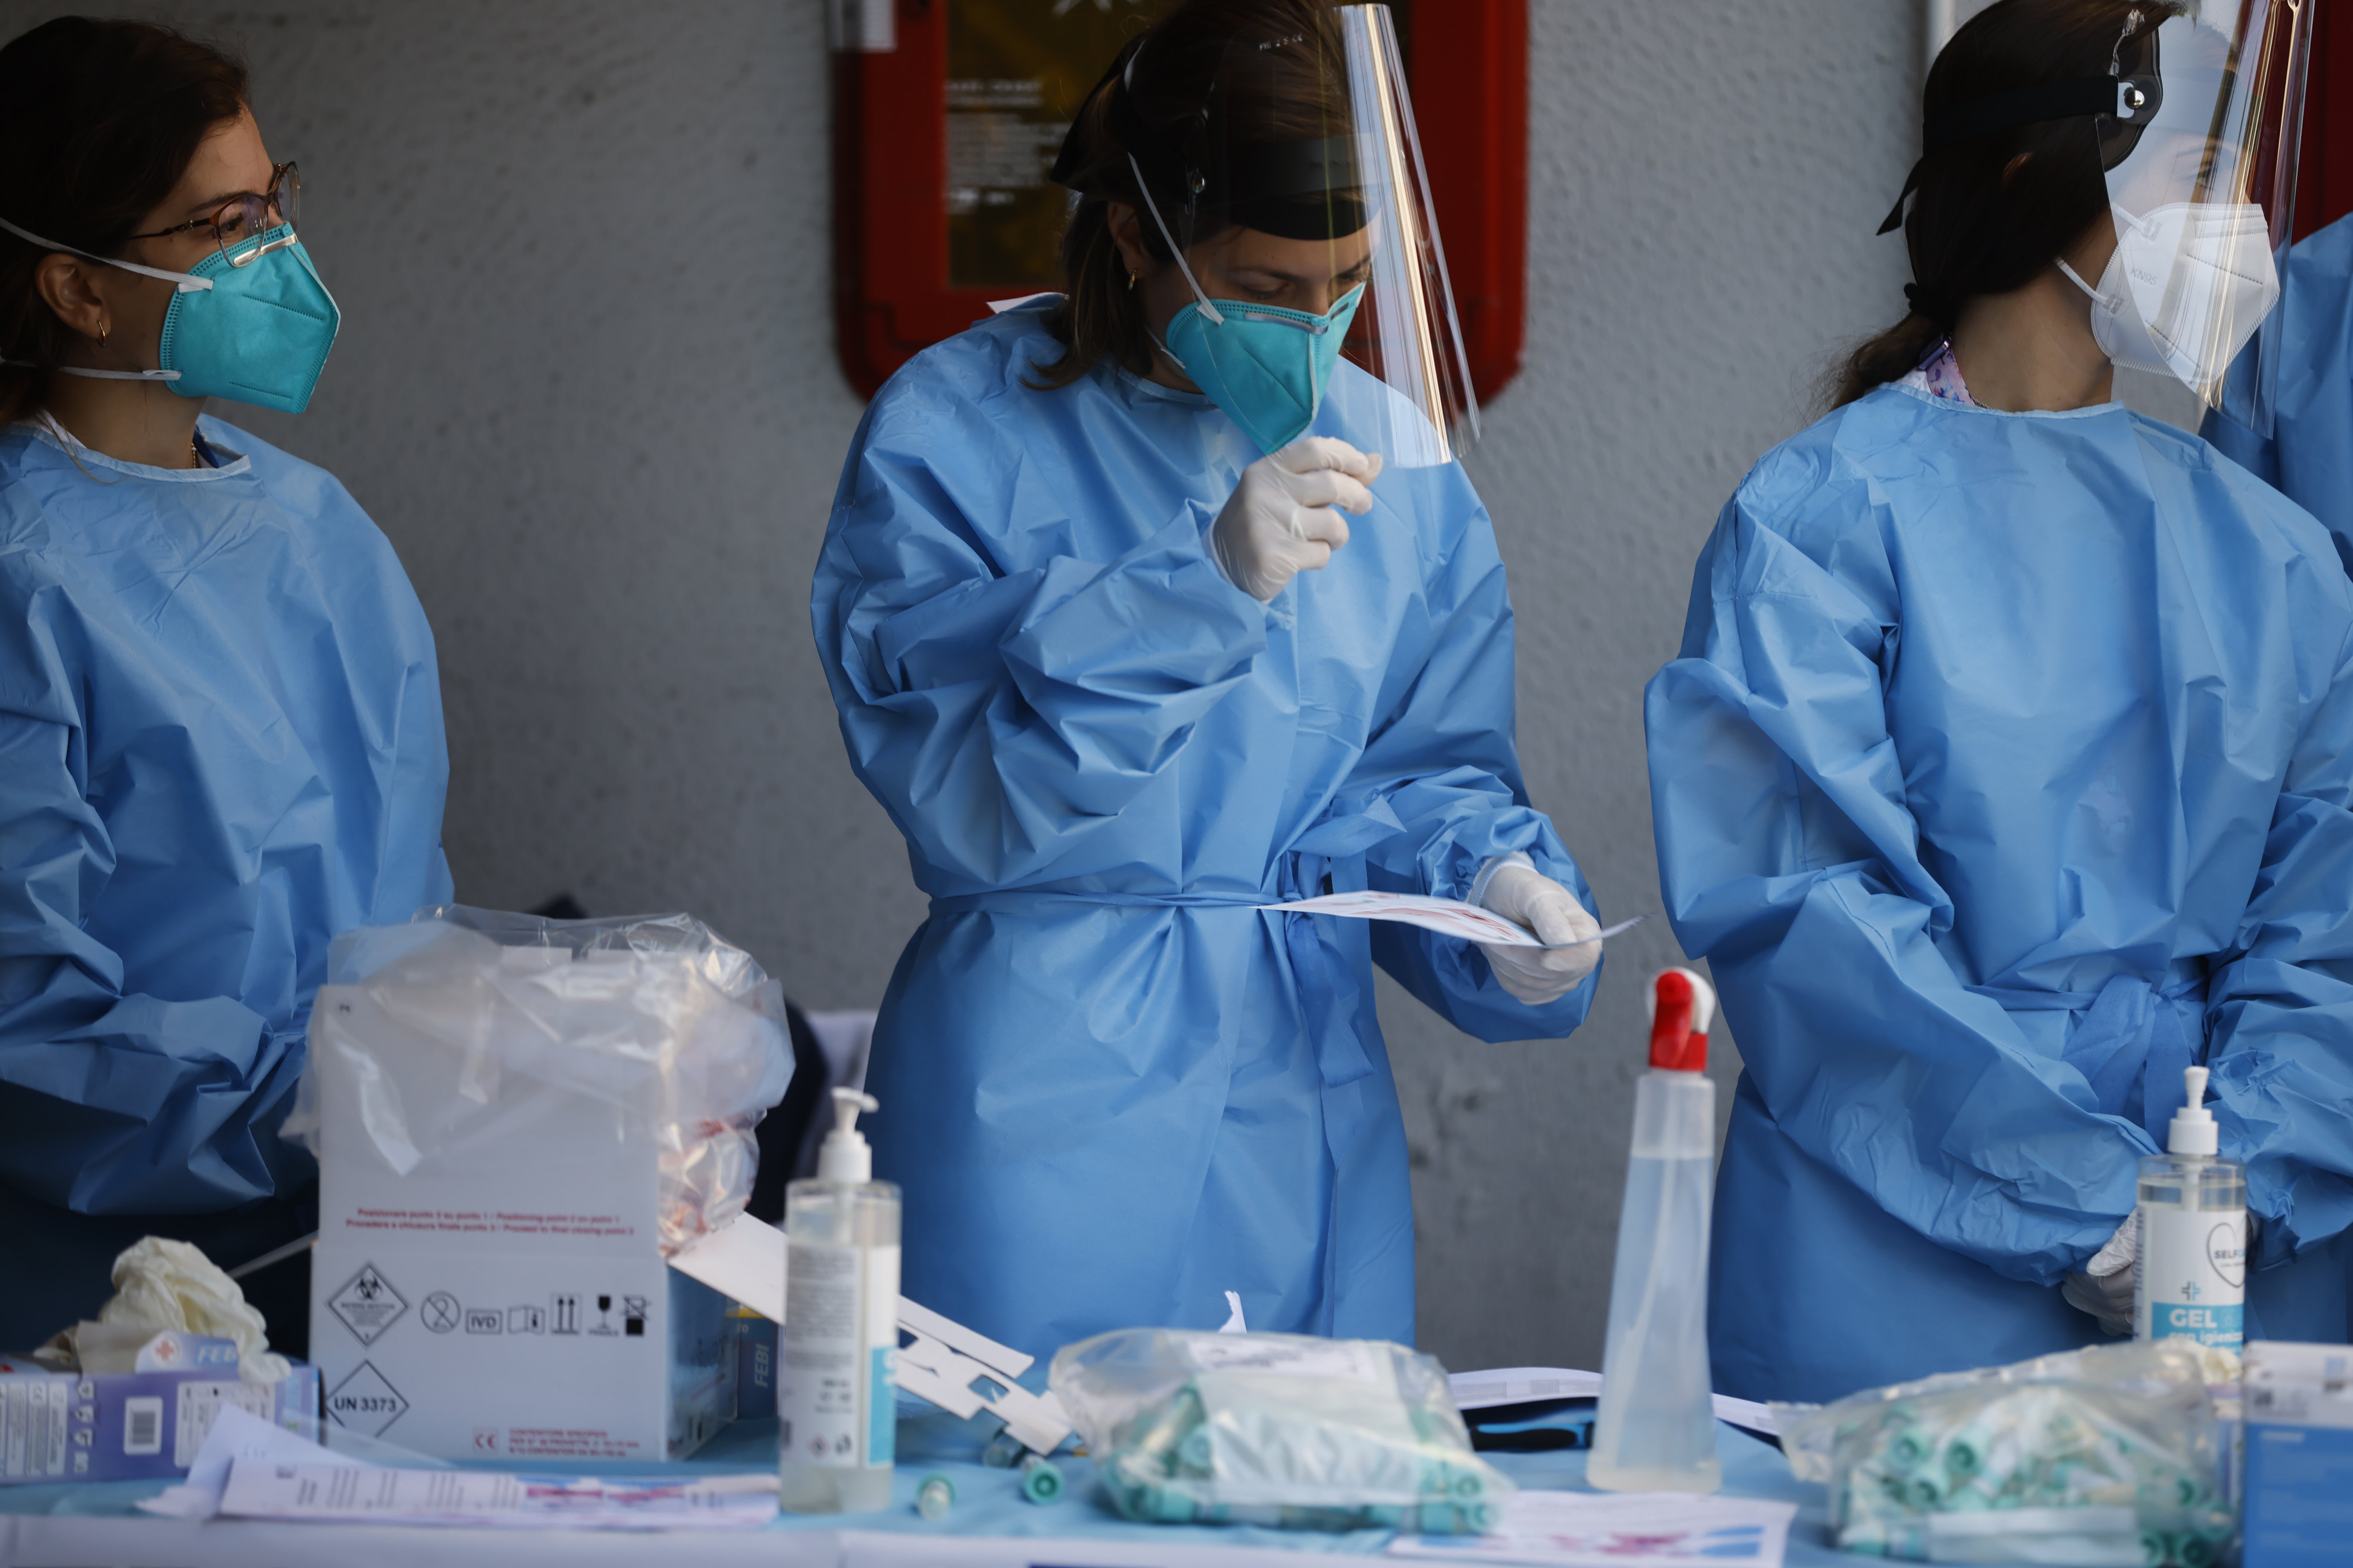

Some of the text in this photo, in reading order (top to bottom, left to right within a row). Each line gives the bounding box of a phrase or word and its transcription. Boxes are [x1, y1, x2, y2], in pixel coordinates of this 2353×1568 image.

[2130, 267, 2158, 285] KN95
[345, 1217, 389, 1229] Procedere
[399, 1219, 435, 1230] chiusura
[438, 1220, 461, 1231] finale
[463, 1222, 487, 1232] punto
[503, 1223, 537, 1233] Proceed
[551, 1225, 568, 1234] final
[571, 1225, 601, 1236] closing
[604, 1227, 627, 1237] point
[409, 1209, 433, 1221] punto
[456, 1210, 481, 1222] punto
[496, 1212, 544, 1225] Positioning
[546, 1214, 568, 1226] point
[591, 1215, 613, 1225] point
[471, 1315, 496, 1329] IVD
[2169, 1308, 2218, 1329] GEL
[196, 1345, 236, 1365] FEB
[754, 1343, 770, 1388] FEBI
[334, 1397, 396, 1412] UN 3373
